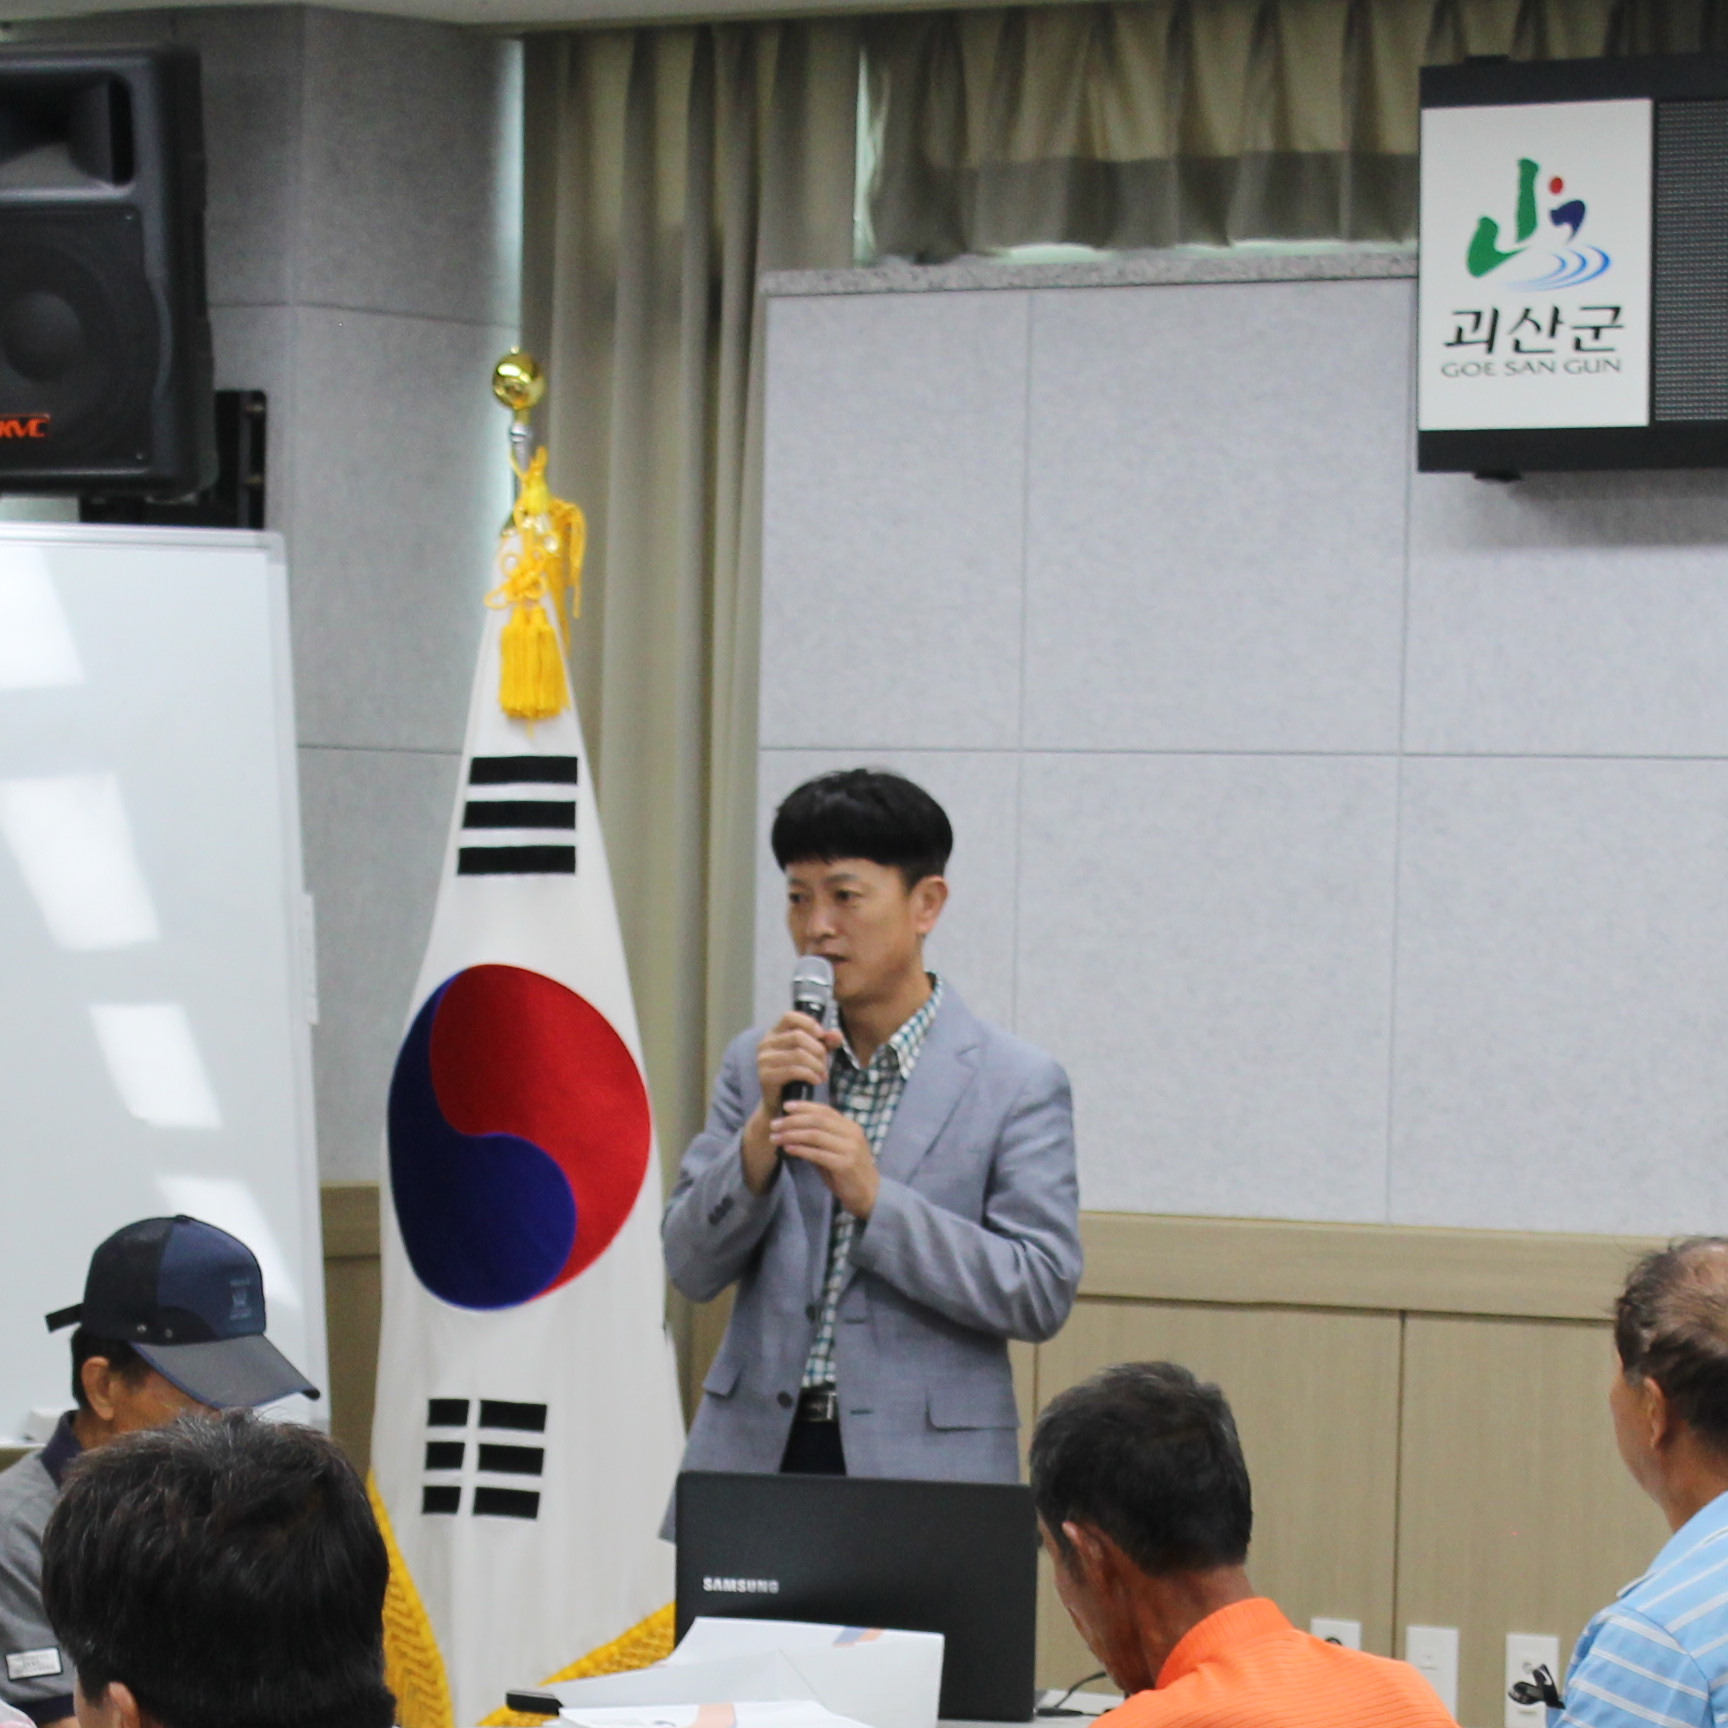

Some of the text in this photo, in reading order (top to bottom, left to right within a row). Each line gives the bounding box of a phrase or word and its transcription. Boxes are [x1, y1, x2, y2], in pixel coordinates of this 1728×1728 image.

[1443, 304, 1625, 355] 괴산군
[1441, 357, 1622, 378] GOE SAN GUN
[702, 1576, 779, 1594] SAMSUNG
